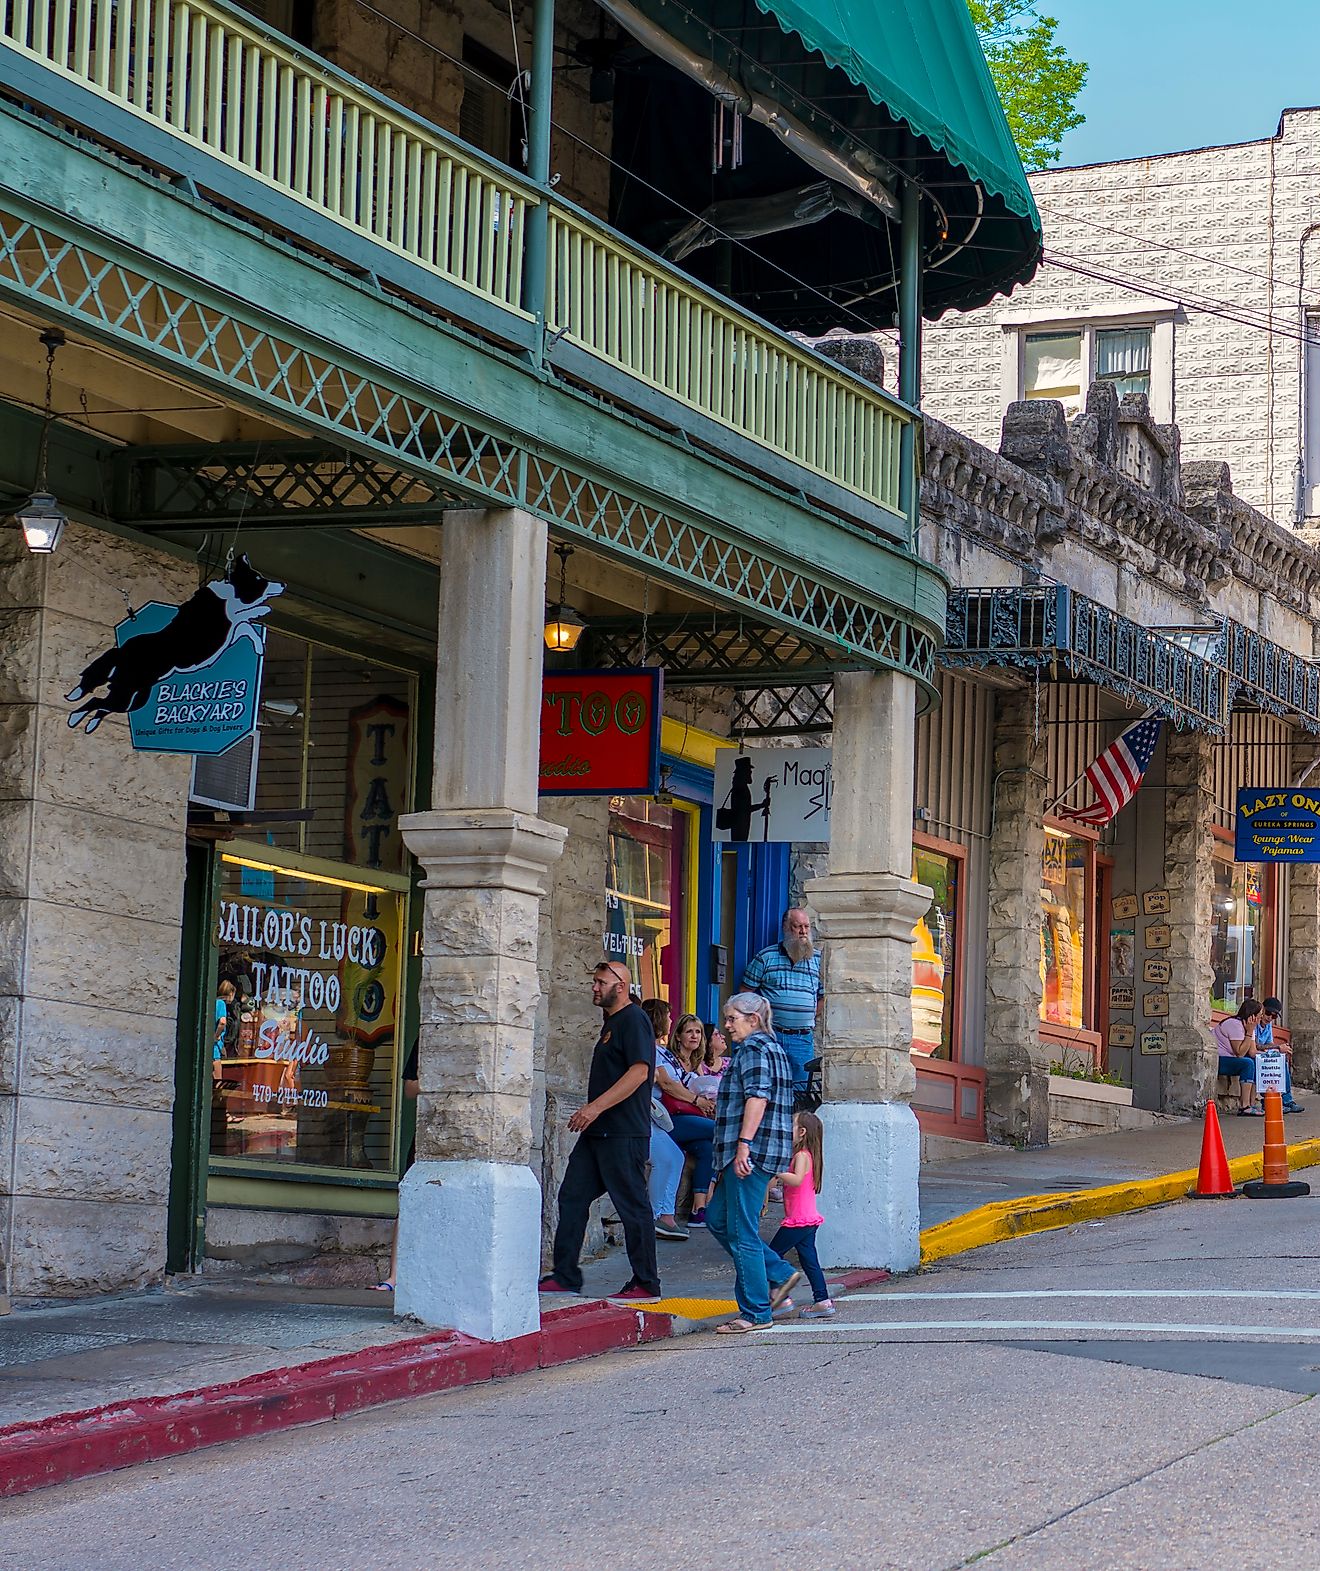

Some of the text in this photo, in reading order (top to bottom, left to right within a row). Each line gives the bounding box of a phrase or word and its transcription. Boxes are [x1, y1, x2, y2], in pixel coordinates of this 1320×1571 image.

[157, 680, 246, 703] BLACKIE'S
[154, 702, 244, 724] BACKYARD
[135, 729, 157, 737] Unique
[158, 727, 174, 736] Gifts
[174, 727, 184, 735] for
[185, 726, 200, 734] Dogs
[209, 725, 221, 733] Dog
[222, 724, 244, 732] Lovers
[1240, 794, 1288, 818] LAZY
[1252, 834, 1316, 845] Lounge Wear
[1261, 846, 1305, 856] Pajamas
[319, 920, 377, 966] LUCK
[251, 961, 341, 1014] TATTOO
[255, 1018, 330, 1066] Studio
[252, 1084, 328, 1108] 479-244-7220
